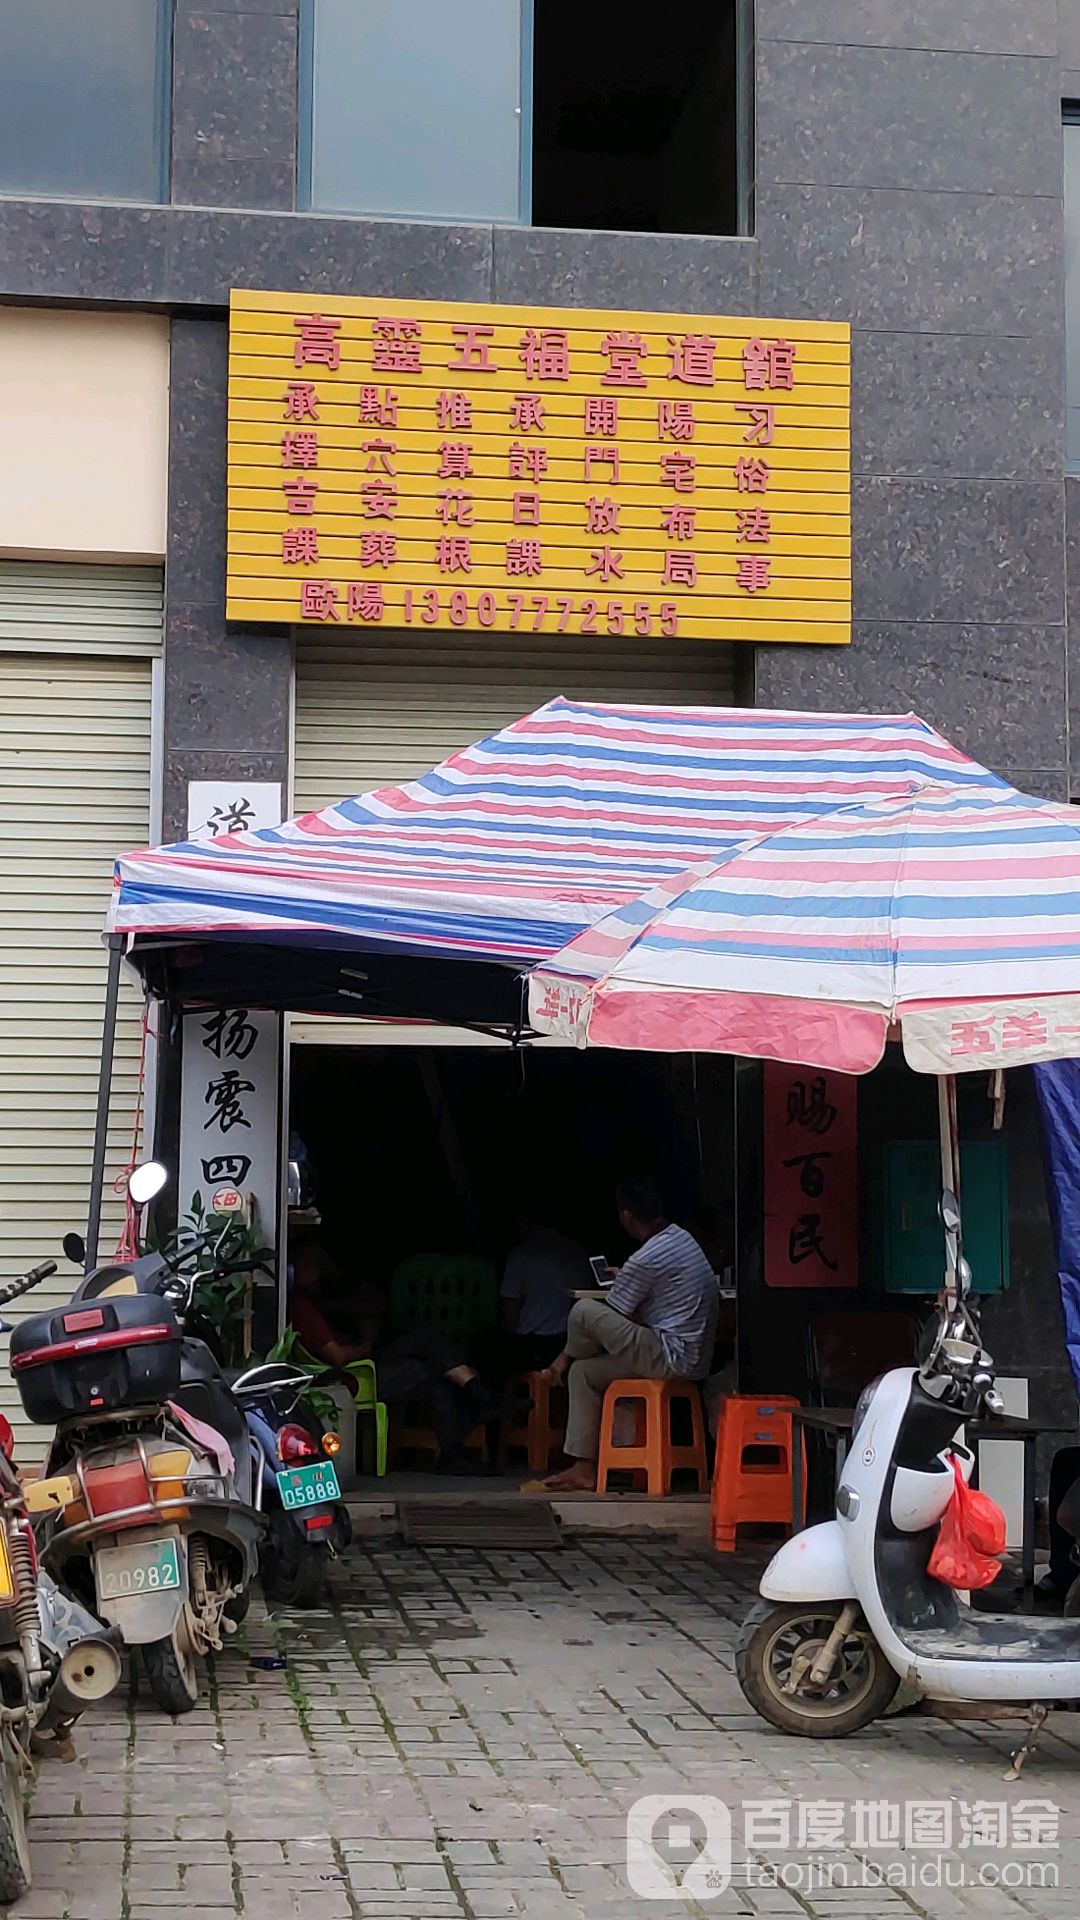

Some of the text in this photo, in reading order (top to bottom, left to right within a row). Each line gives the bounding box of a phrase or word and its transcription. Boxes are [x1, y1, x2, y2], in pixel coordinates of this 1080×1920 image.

[281, 382, 320, 566] 承擇吉課
[358, 386, 399, 568] 點穴安葬
[435, 390, 475, 574] 推算花根
[506, 394, 548, 576] 承評日課
[584, 398, 625, 582] 開門放水
[657, 401, 698, 588] 陽宅布局
[733, 403, 777, 593] 习俗法事
[301, 579, 679, 636] 歐陽 13807772555
[105, 1563, 175, 1593] 20982
